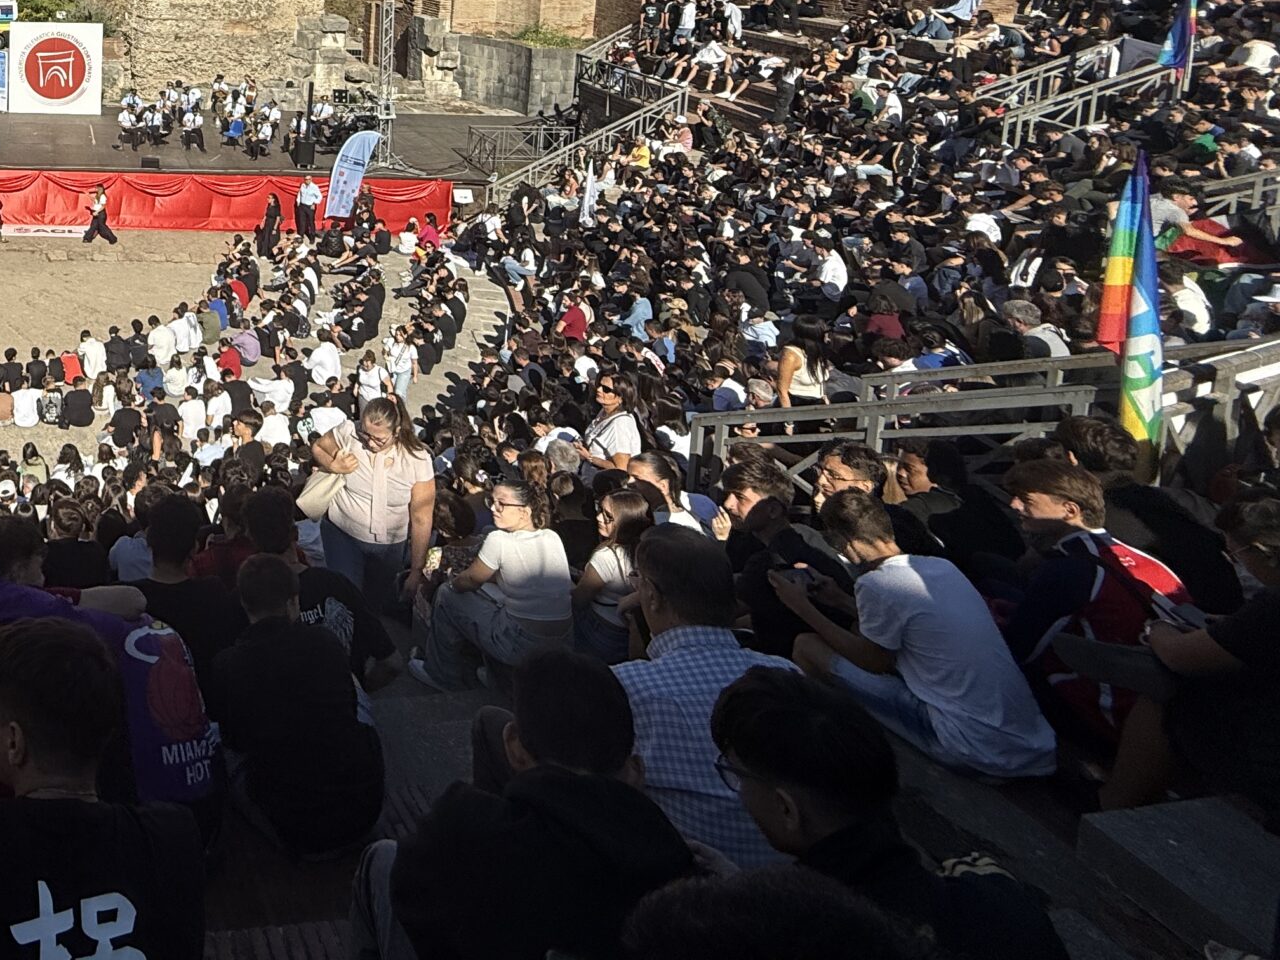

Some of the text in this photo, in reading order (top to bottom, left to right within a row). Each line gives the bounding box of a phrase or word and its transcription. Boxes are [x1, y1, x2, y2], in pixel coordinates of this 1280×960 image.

[56, 31, 83, 48] GIUSTINO
[81, 46, 94, 84] FORTUNATO
[300, 603, 325, 625] ngel
[185, 759, 211, 786] HOT
